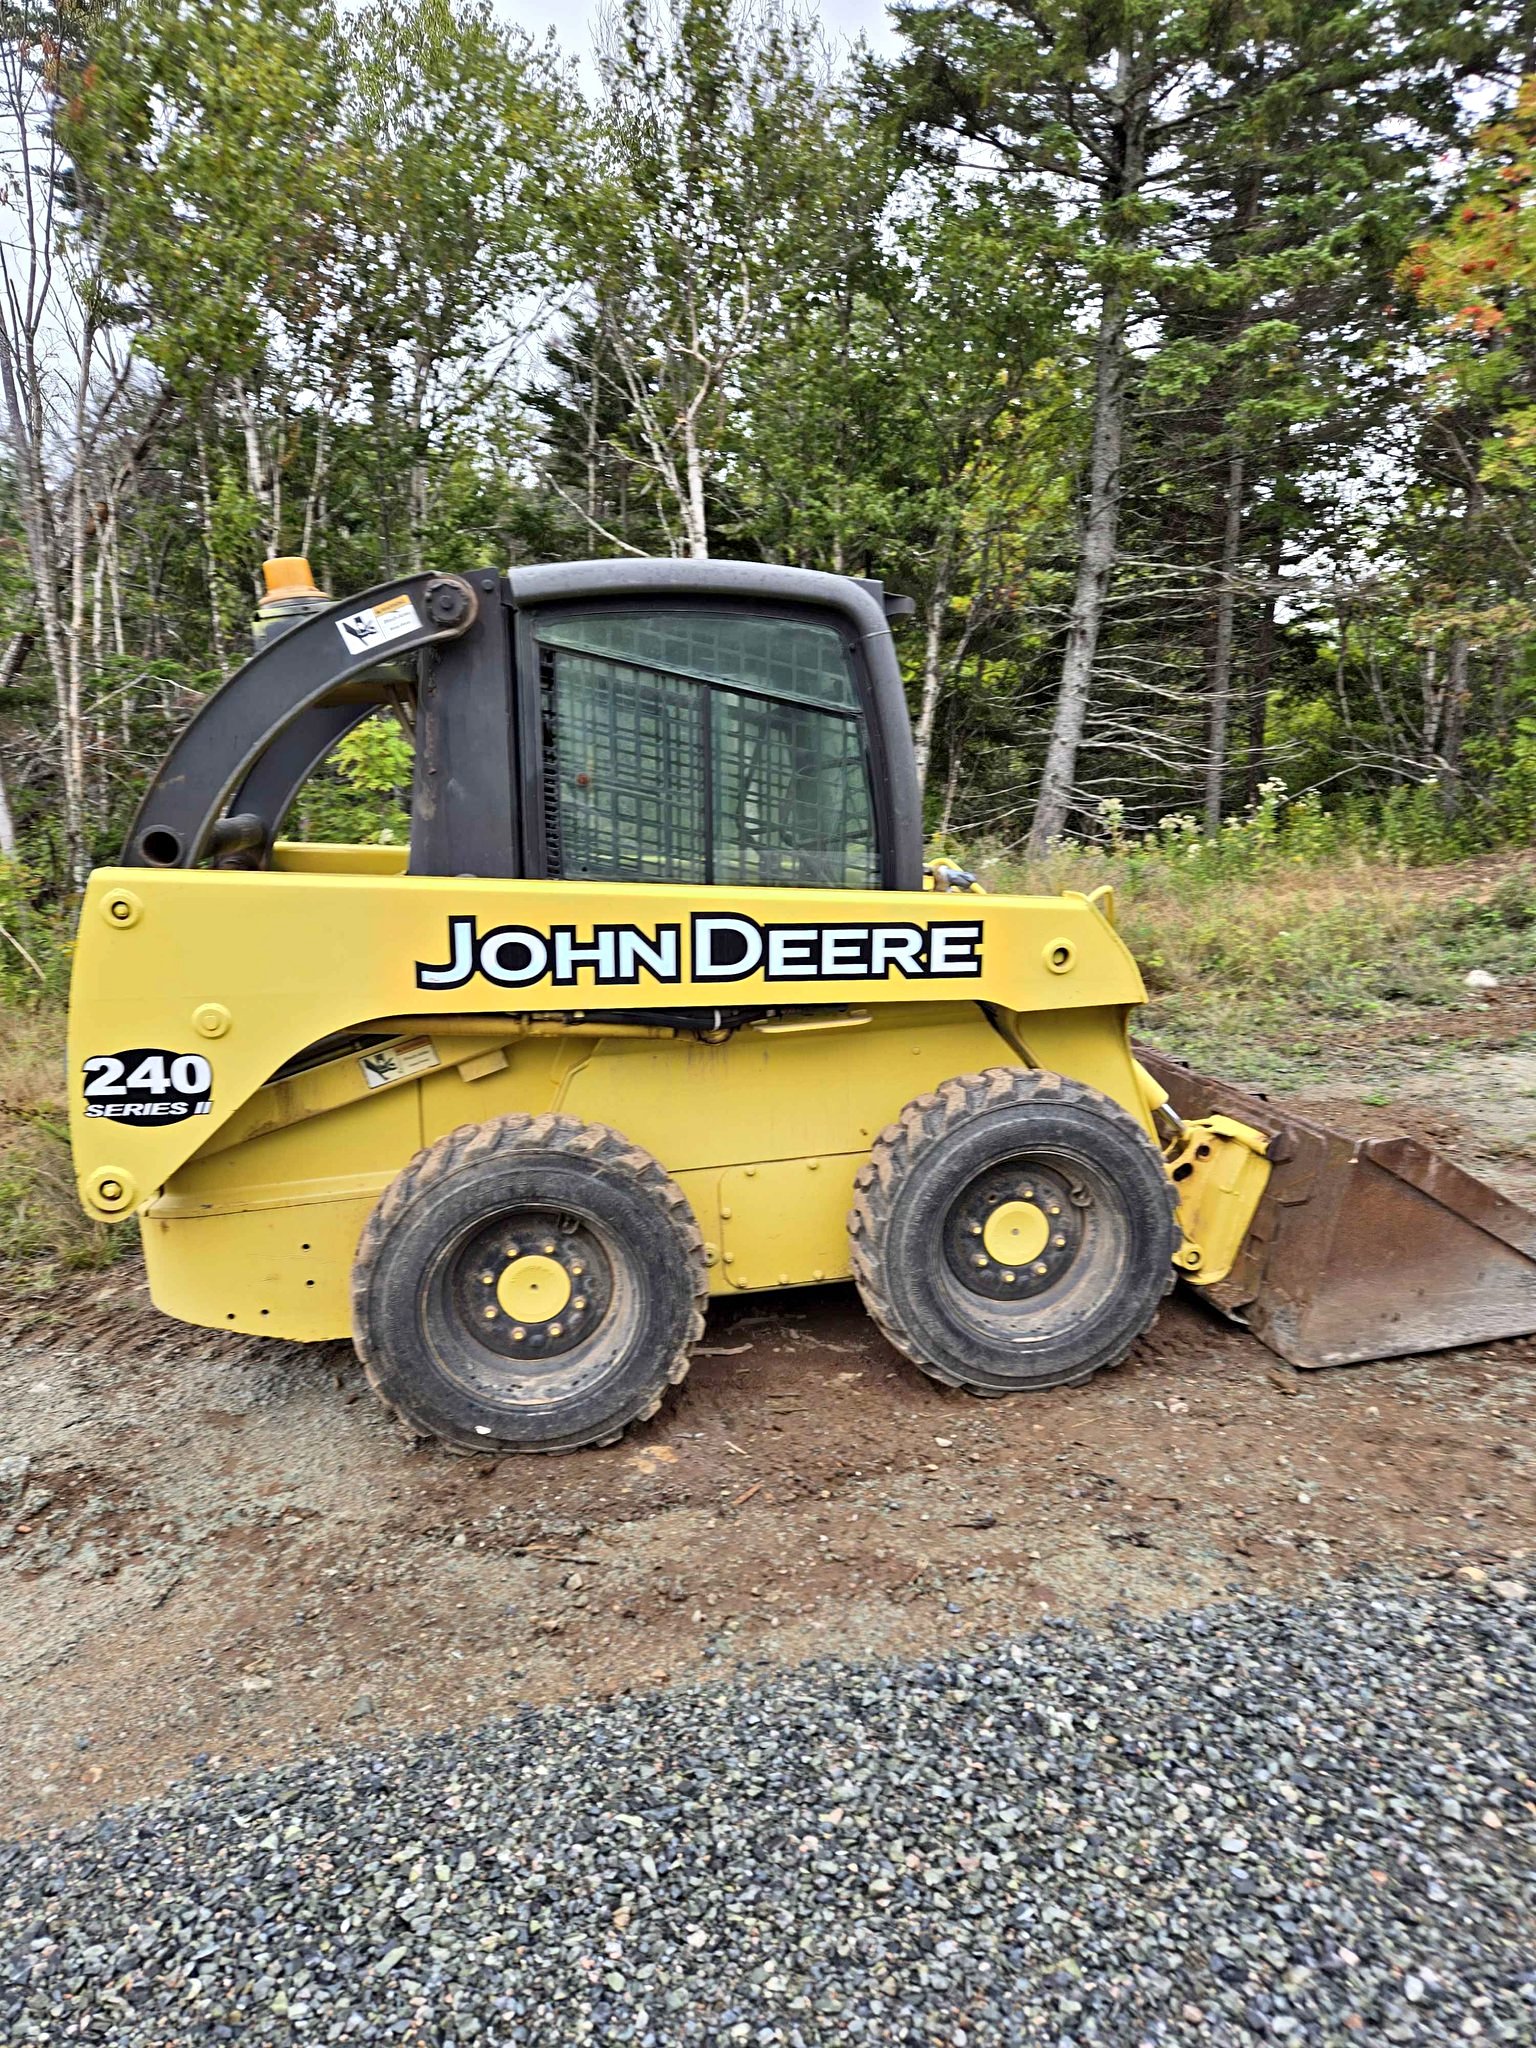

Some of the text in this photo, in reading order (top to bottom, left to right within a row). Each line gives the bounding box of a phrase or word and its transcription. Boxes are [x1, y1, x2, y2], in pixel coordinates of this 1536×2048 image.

[418, 915, 981, 986] JOHN DEERE
[83, 1055, 212, 1096] 240
[85, 1101, 213, 1117] SERIES II
